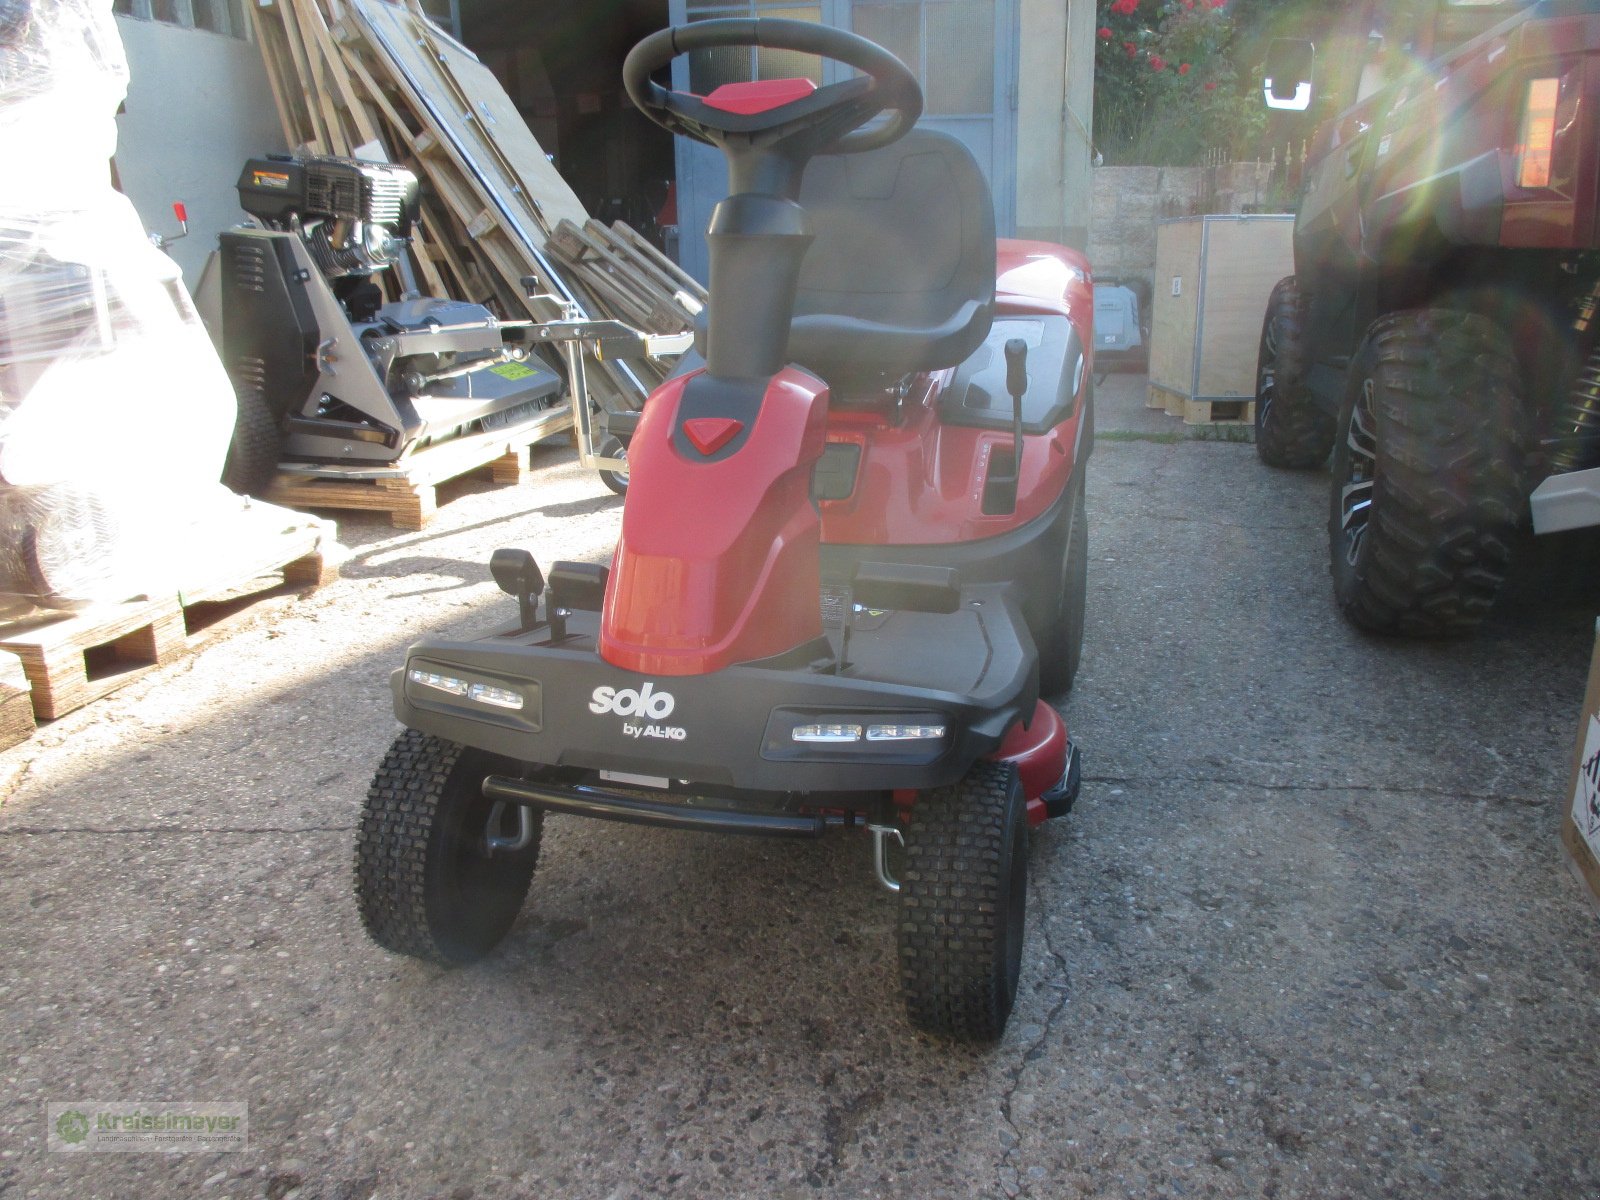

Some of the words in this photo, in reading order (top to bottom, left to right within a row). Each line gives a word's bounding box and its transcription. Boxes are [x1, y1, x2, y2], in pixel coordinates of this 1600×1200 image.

[588, 682, 675, 720] solo
[623, 723, 643, 738] by
[643, 725, 687, 740] AL-KO
